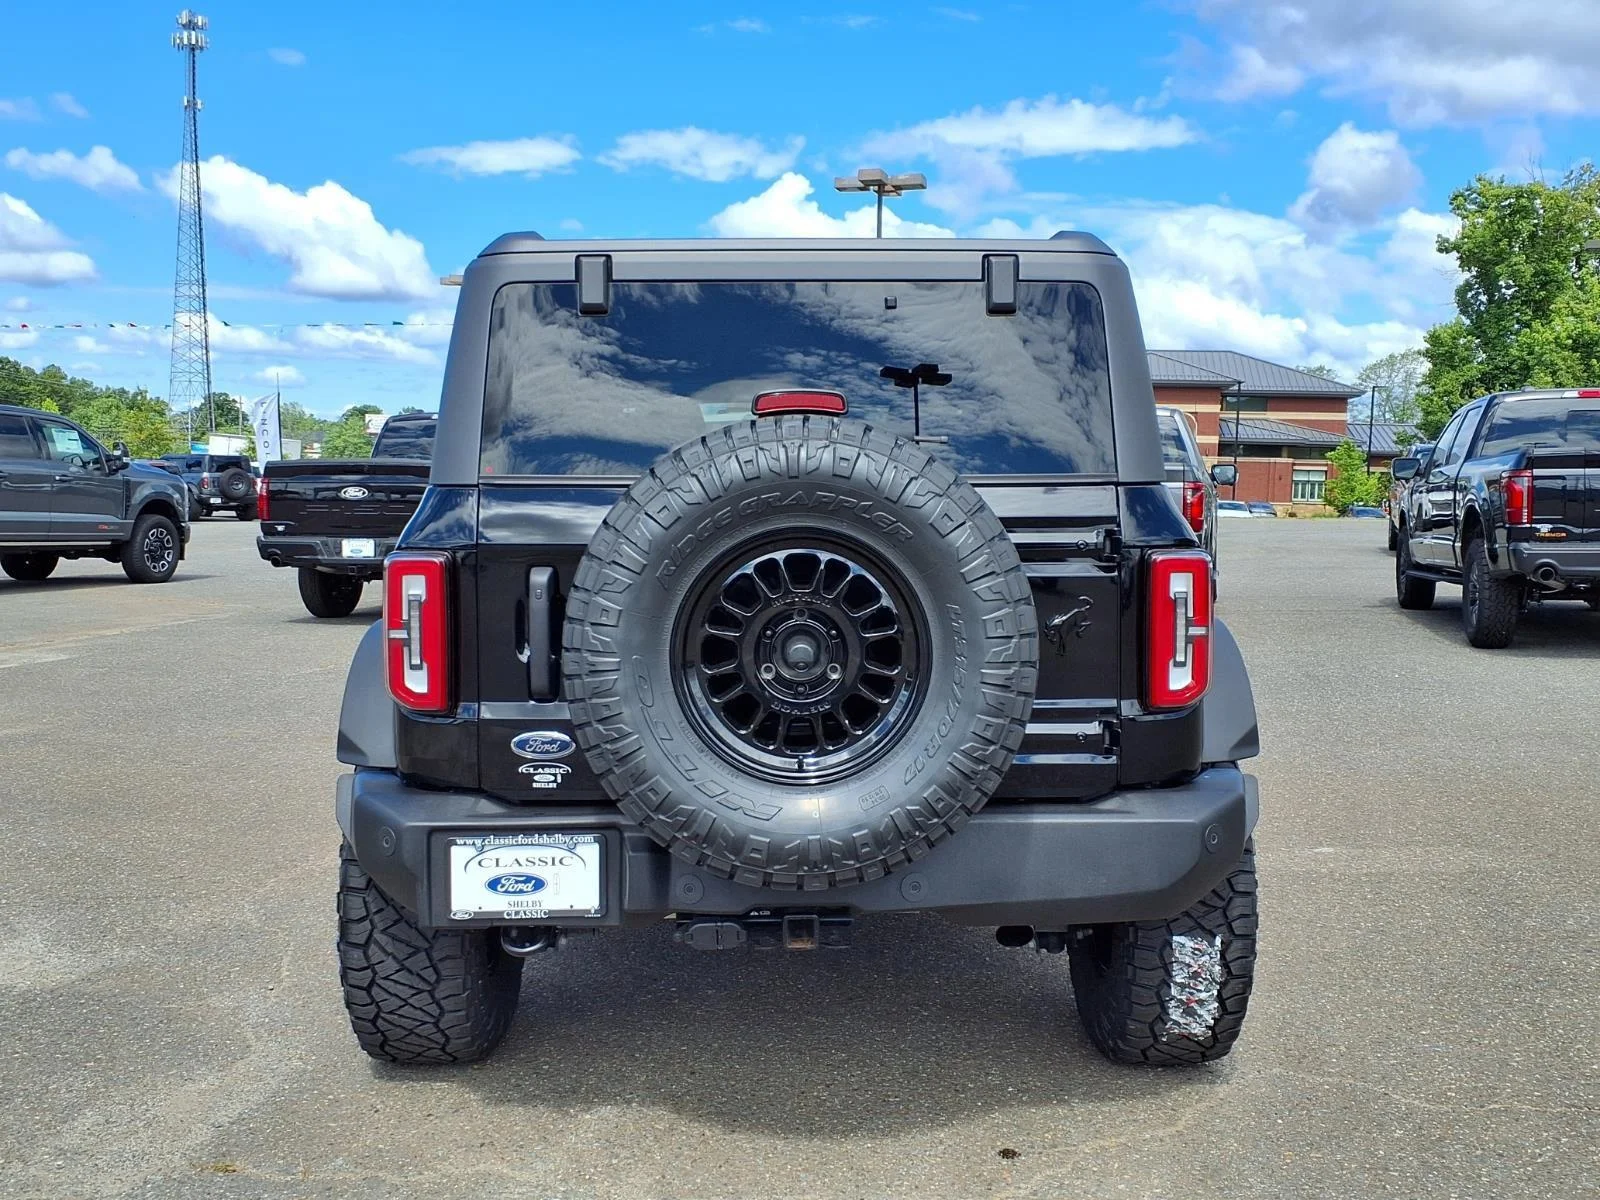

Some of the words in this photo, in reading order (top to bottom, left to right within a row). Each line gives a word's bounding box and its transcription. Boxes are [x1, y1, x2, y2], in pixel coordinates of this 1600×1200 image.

[260, 401, 271, 460] LINCOL
[655, 506, 733, 590] RIDGE
[738, 490, 915, 542] GRAPPLER
[632, 655, 784, 822] NITTO
[456, 834, 595, 847] www.classicfordshelby.com
[478, 856, 574, 869] CLASSIC
[496, 876, 535, 893] Ford
[507, 900, 544, 909] SHELBY
[503, 909, 549, 919] CLASSIC
